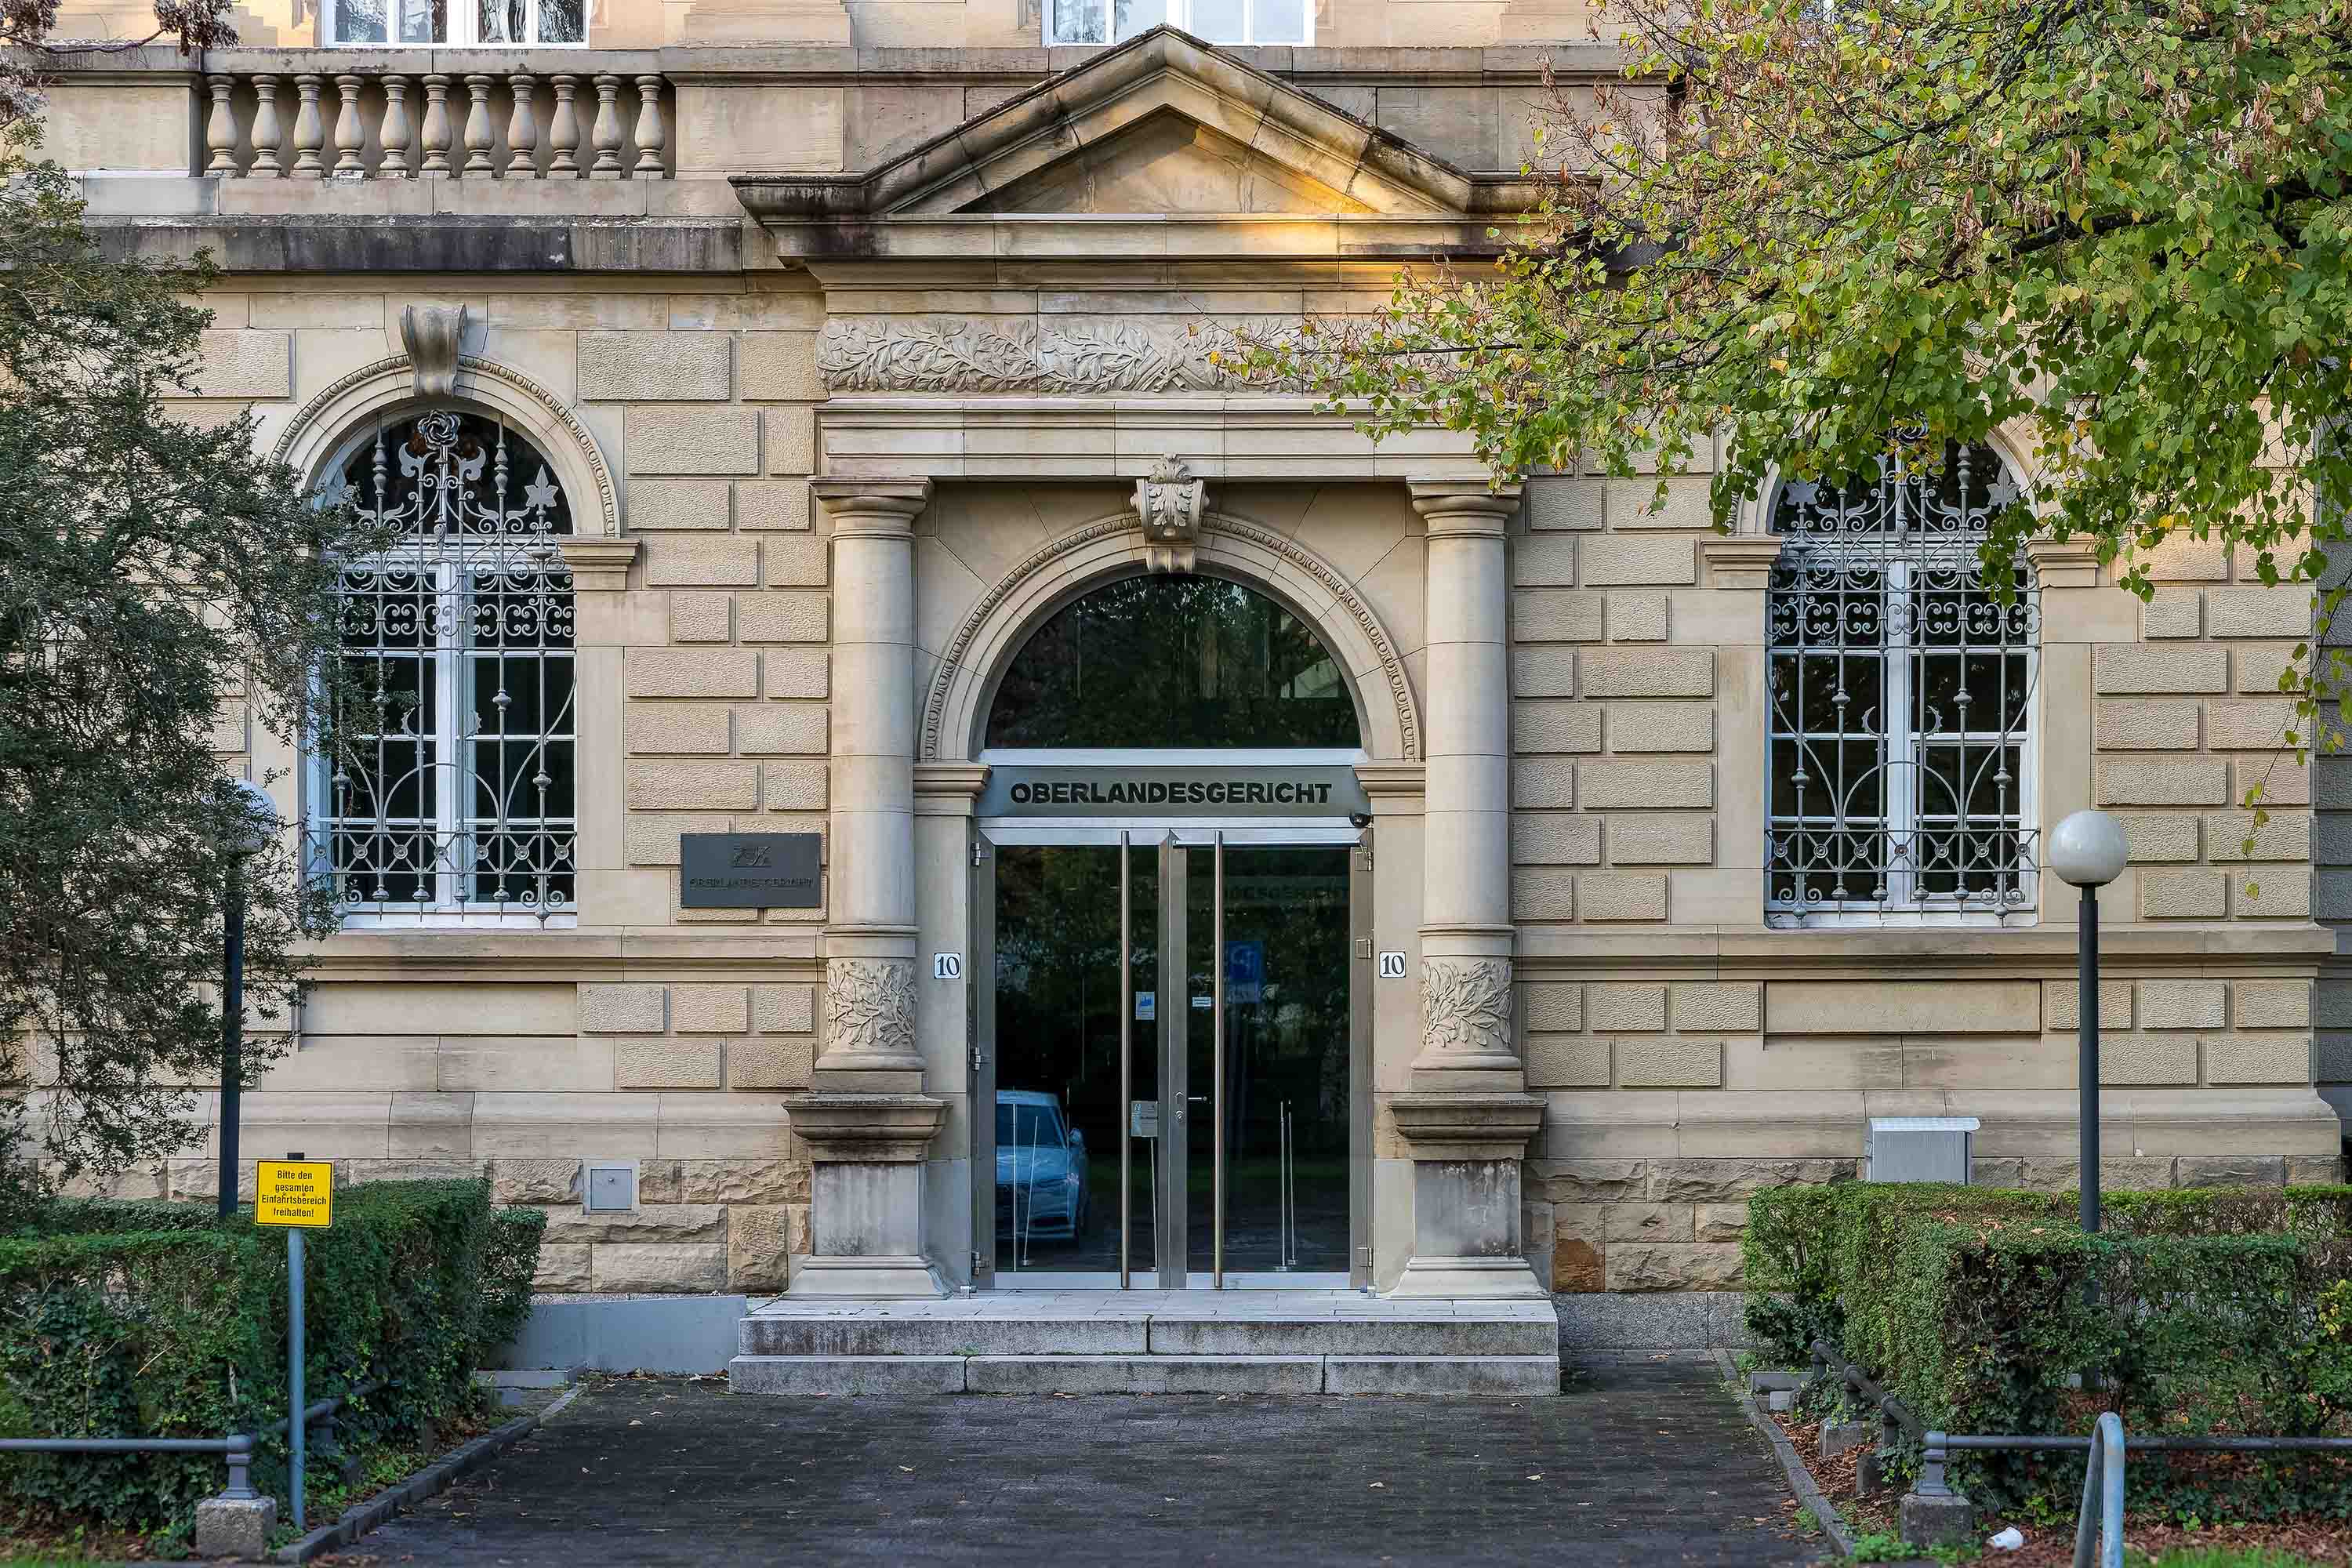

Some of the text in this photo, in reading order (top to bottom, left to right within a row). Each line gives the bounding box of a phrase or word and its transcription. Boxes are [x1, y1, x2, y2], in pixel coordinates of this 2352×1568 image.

[1010, 782, 1332, 804] OBERLANDESGERICHT
[937, 956, 960, 975] 10
[1382, 955, 1405, 975] 10
[277, 1170, 313, 1179] Bitte den
[275, 1184, 314, 1192] gesamten
[262, 1195, 327, 1205] Einfahrtsbereich
[274, 1207, 314, 1218] freihalten!
